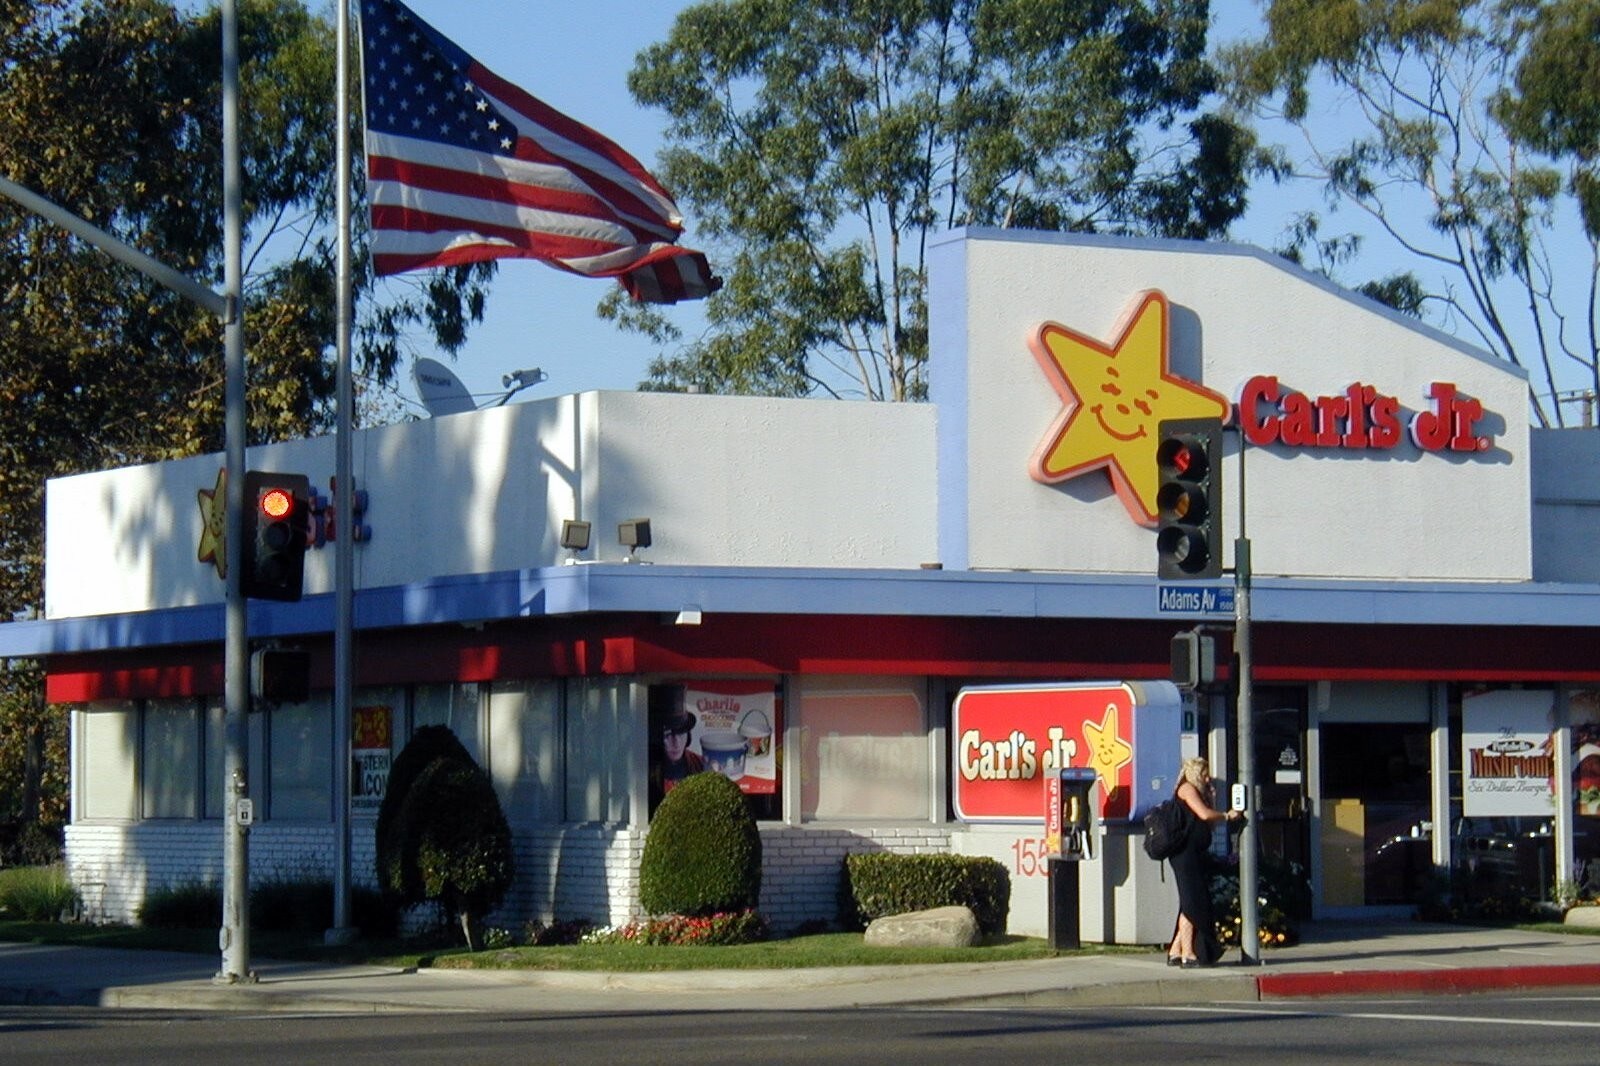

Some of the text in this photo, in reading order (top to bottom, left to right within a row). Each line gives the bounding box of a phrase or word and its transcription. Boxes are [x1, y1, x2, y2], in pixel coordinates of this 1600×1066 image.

[1239, 375, 1490, 450] Carl's Jr.
[1161, 588, 1200, 610] Adams
[1202, 588, 1216, 610] Av
[960, 730, 1037, 781] Carl's
[1469, 748, 1550, 779] Mushroom
[1469, 780, 1548, 796] Six Dollar Burger
